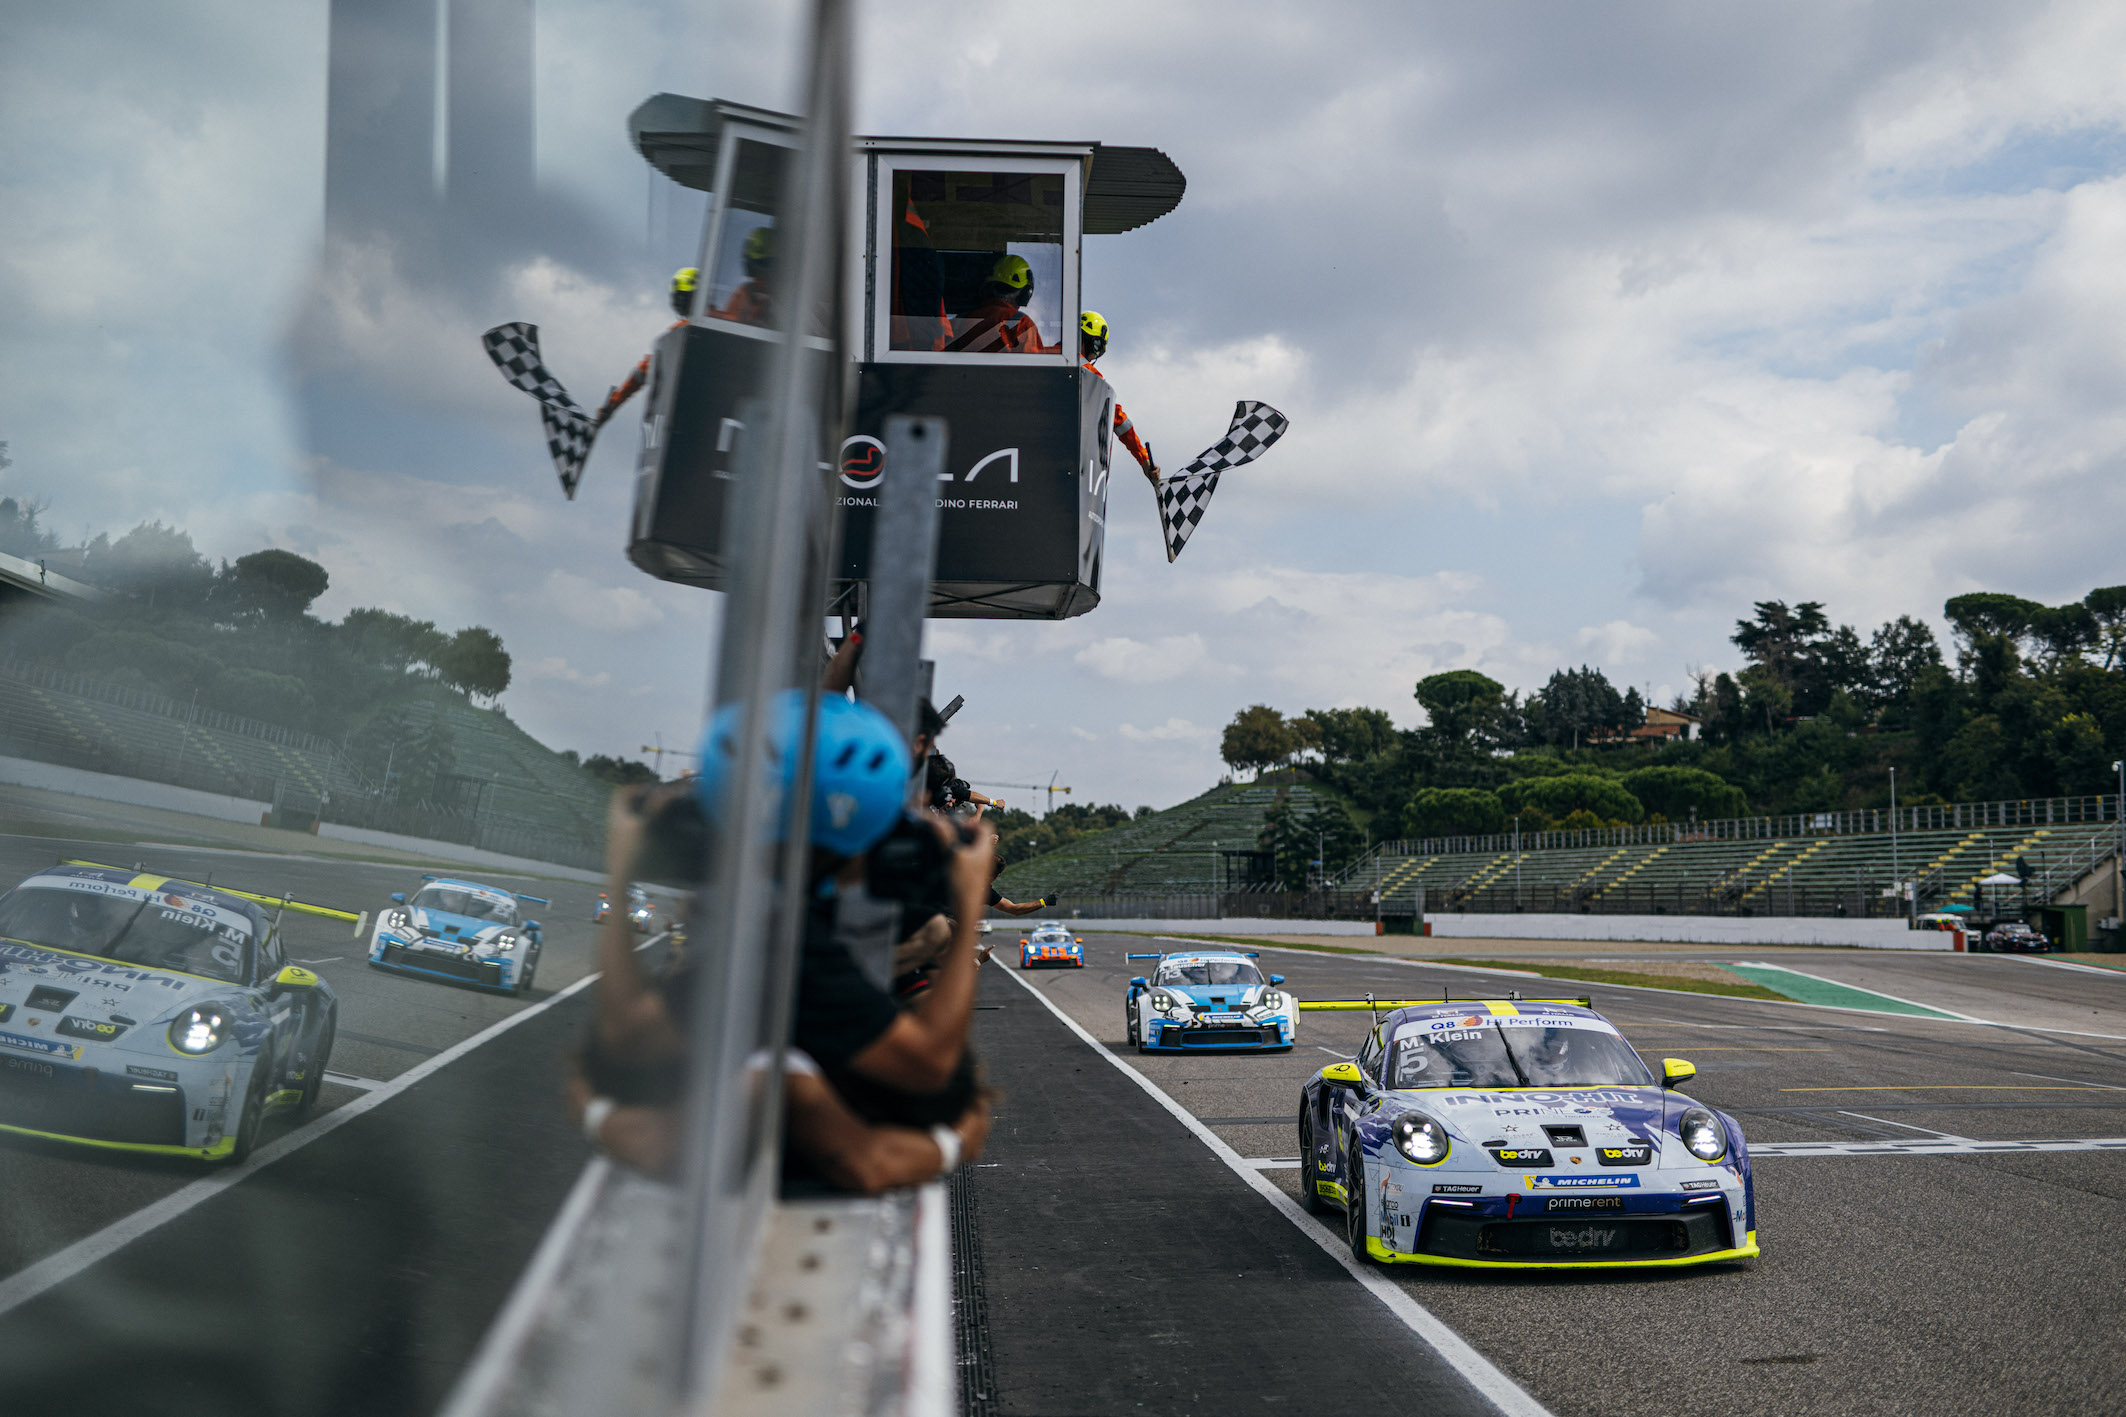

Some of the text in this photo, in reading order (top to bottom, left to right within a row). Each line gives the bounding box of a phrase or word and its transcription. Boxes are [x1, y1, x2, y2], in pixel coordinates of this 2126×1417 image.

[935, 499, 965, 508] DINO
[969, 499, 1018, 509] FERRARI
[1431, 1021, 1455, 1030] Q8
[1509, 1017, 1573, 1027] Perform
[1400, 1030, 1482, 1051] M. Klein
[1401, 1048, 1428, 1074] 5
[1500, 1150, 1544, 1159] bedrv
[1604, 1148, 1646, 1158] bedrv
[1557, 1177, 1632, 1186] MICHELIN
[1548, 1196, 1621, 1211] primerent
